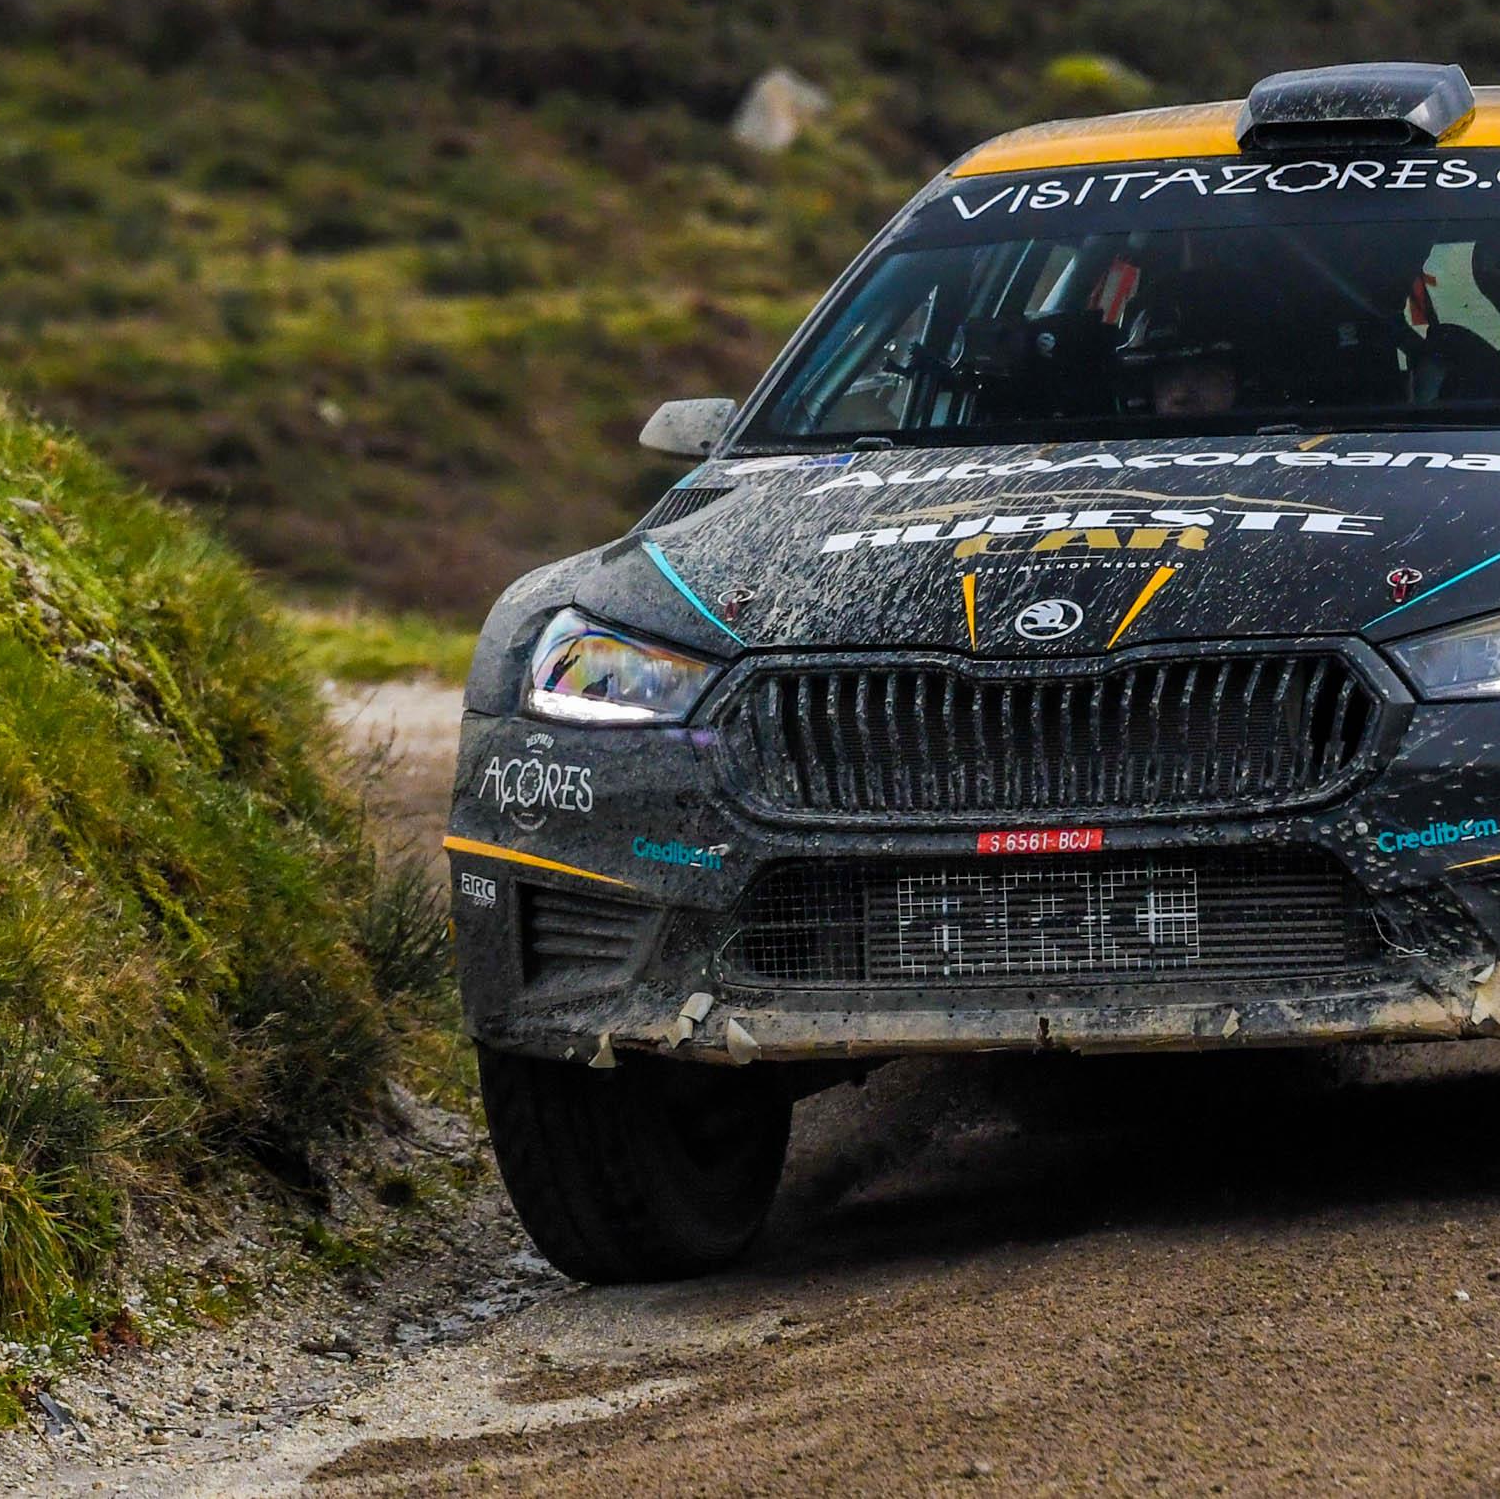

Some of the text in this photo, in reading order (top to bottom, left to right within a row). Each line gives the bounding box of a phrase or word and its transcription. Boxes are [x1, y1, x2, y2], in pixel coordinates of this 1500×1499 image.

[820, 506, 1384, 554] RUBESTE
[953, 526, 1209, 559] CAR
[1017, 562, 1092, 573] MELHOR
[478, 756, 593, 814] AÇORES
[1378, 818, 1498, 853] Credibom
